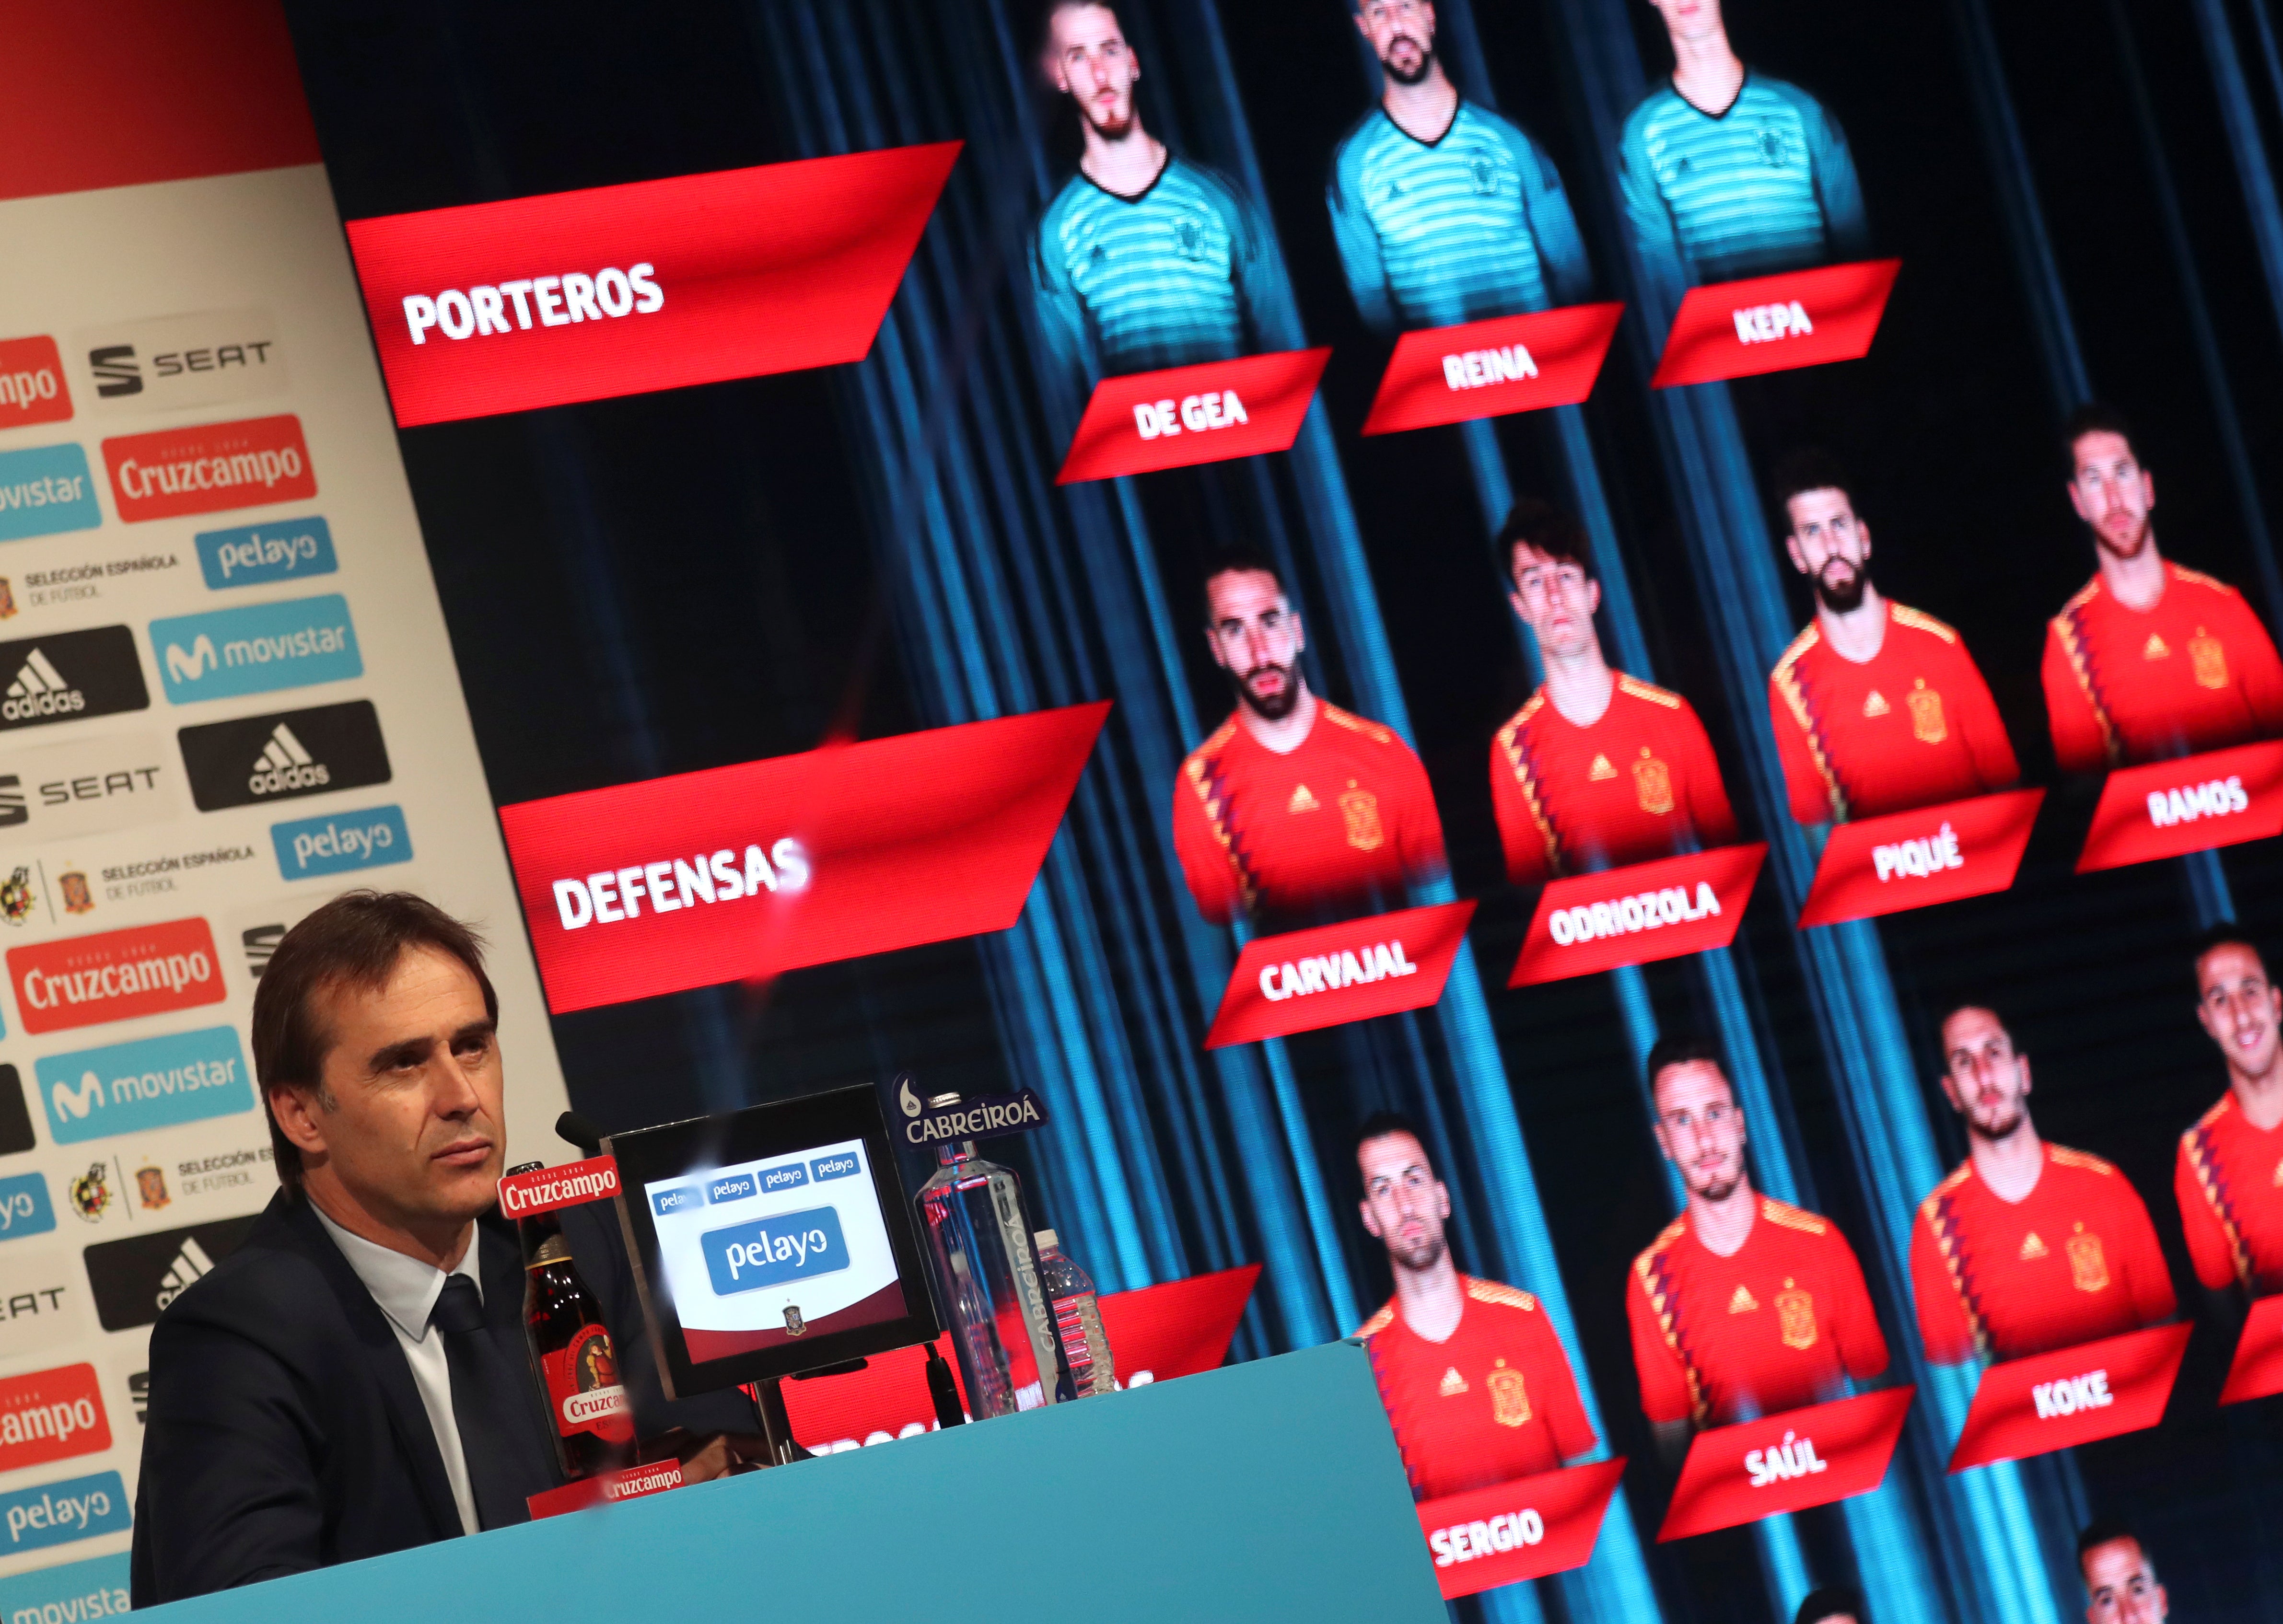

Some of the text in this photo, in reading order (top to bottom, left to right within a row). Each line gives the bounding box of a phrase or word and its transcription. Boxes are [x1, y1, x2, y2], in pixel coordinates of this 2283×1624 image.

[402, 262, 664, 345] PORTEROS
[1732, 300, 1814, 346] KEPA
[153, 341, 272, 377] SEAT
[1441, 344, 1538, 392] REINA
[1132, 390, 1248, 440] DE GEA
[0, 476, 83, 510] vistar
[118, 446, 302, 500] Cruzcampo
[217, 533, 318, 579] pelayo
[224, 625, 347, 668] movistar
[2, 689, 85, 721] adidas
[39, 767, 161, 807] SEAT
[249, 764, 330, 795] adidas
[2147, 775, 2248, 829] RAMOS
[292, 823, 394, 868] pelayo
[1872, 820, 1963, 883] PIQUÉ
[552, 837, 809, 930] DEFENSAS
[1548, 881, 1721, 946] ODRIOZOLA
[23, 951, 211, 1010] Cruzcampo
[1259, 940, 1417, 1001] CARVAJAL
[112, 1057, 236, 1104] movistar
[906, 1094, 1040, 1144] CABREIROÁ
[506, 1170, 617, 1211] Cruzcampo
[713, 1180, 750, 1200] pelayo
[766, 1170, 803, 1188] pelayo
[817, 1159, 854, 1177] pelayo
[660, 1193, 687, 1211] pela
[725, 1229, 827, 1281] pelayo
[1003, 1213, 1056, 1353] CABREIROÁ
[570, 1394, 625, 1417] Cruzca
[2032, 1369, 2113, 1419] KOKE
[1744, 1428, 1827, 1487] SAÚL
[6, 1491, 111, 1543] pelayo
[1429, 1508, 1545, 1568] SERGIO
[13, 1588, 131, 1624] movista
